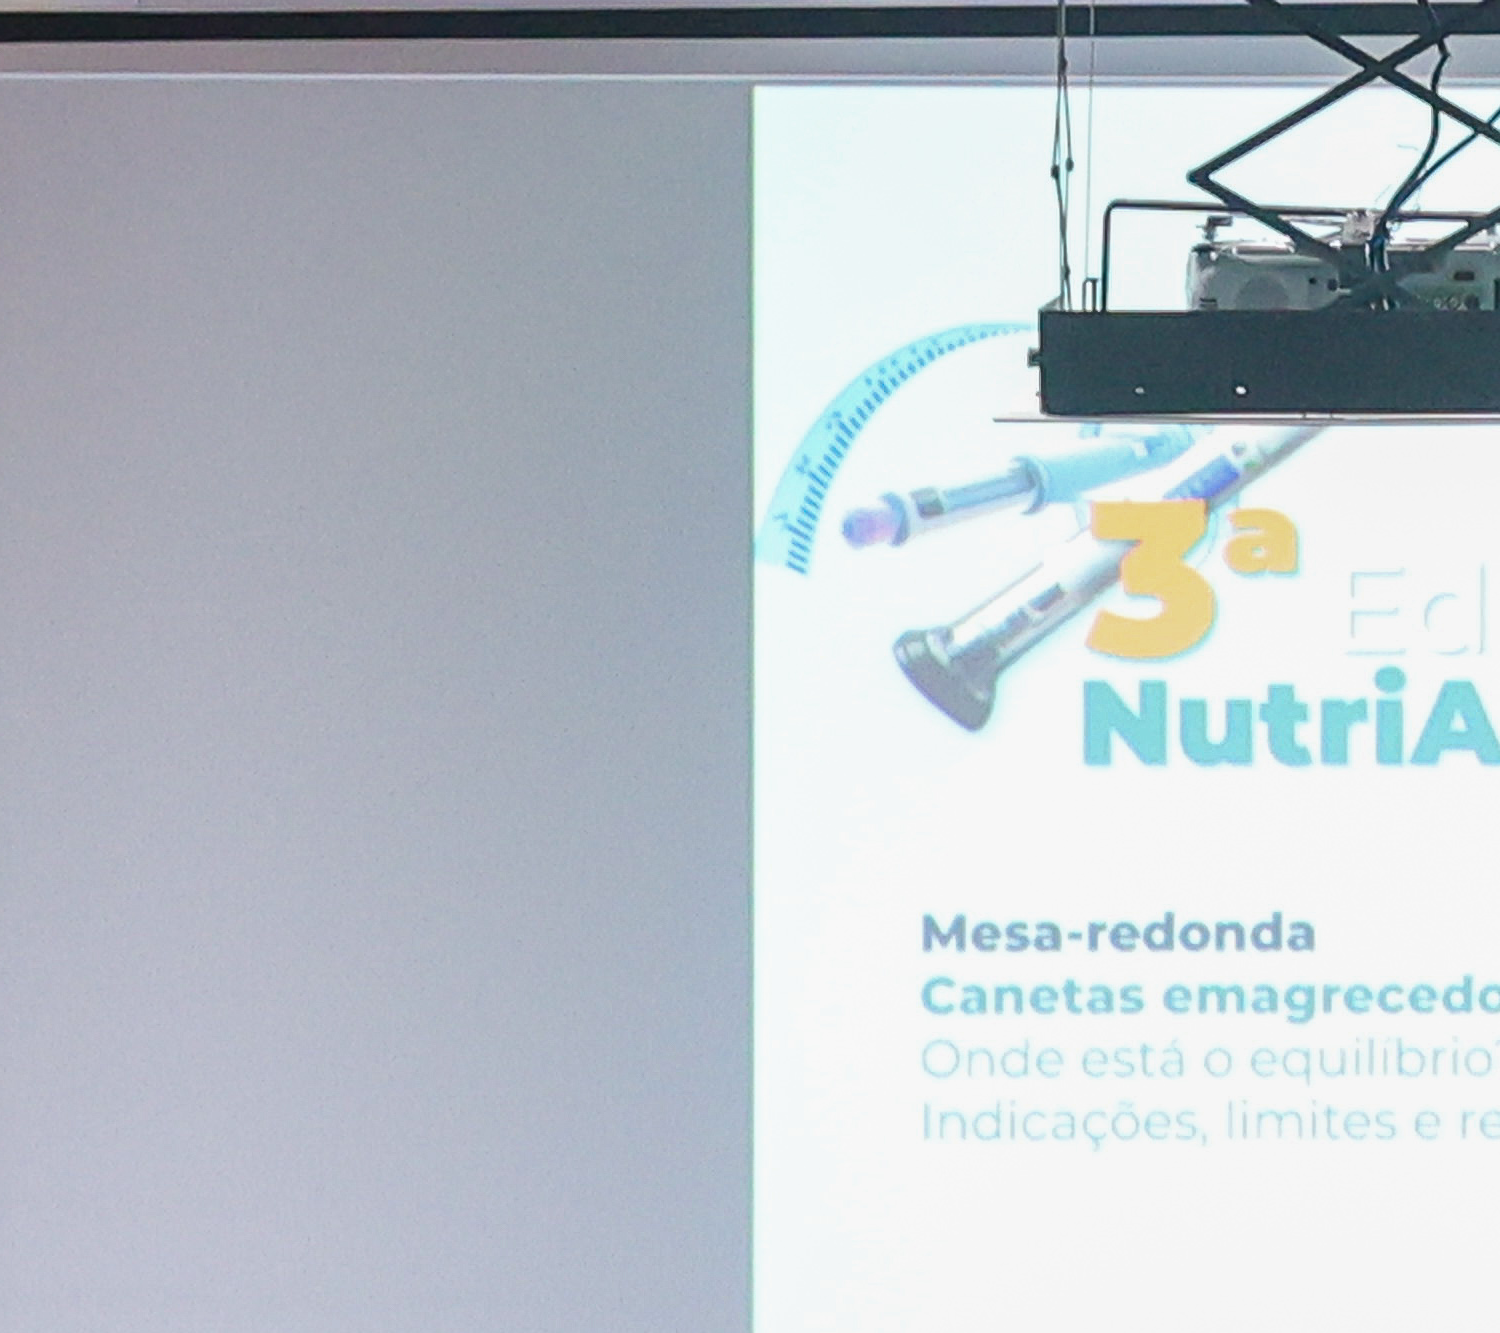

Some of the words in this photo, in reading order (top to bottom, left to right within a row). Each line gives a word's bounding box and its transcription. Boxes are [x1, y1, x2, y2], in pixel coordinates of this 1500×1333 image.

[921, 910, 1318, 955] Mesa-redonda
[920, 975, 1148, 1018] Canetas
[921, 1037, 1067, 1081] Onde
[1080, 1037, 1187, 1081] está
[1203, 1047, 1236, 1080] o
[923, 1099, 1209, 1153] Indicações,
[1228, 1100, 1399, 1143] limites
[1414, 1110, 1443, 1143] e
